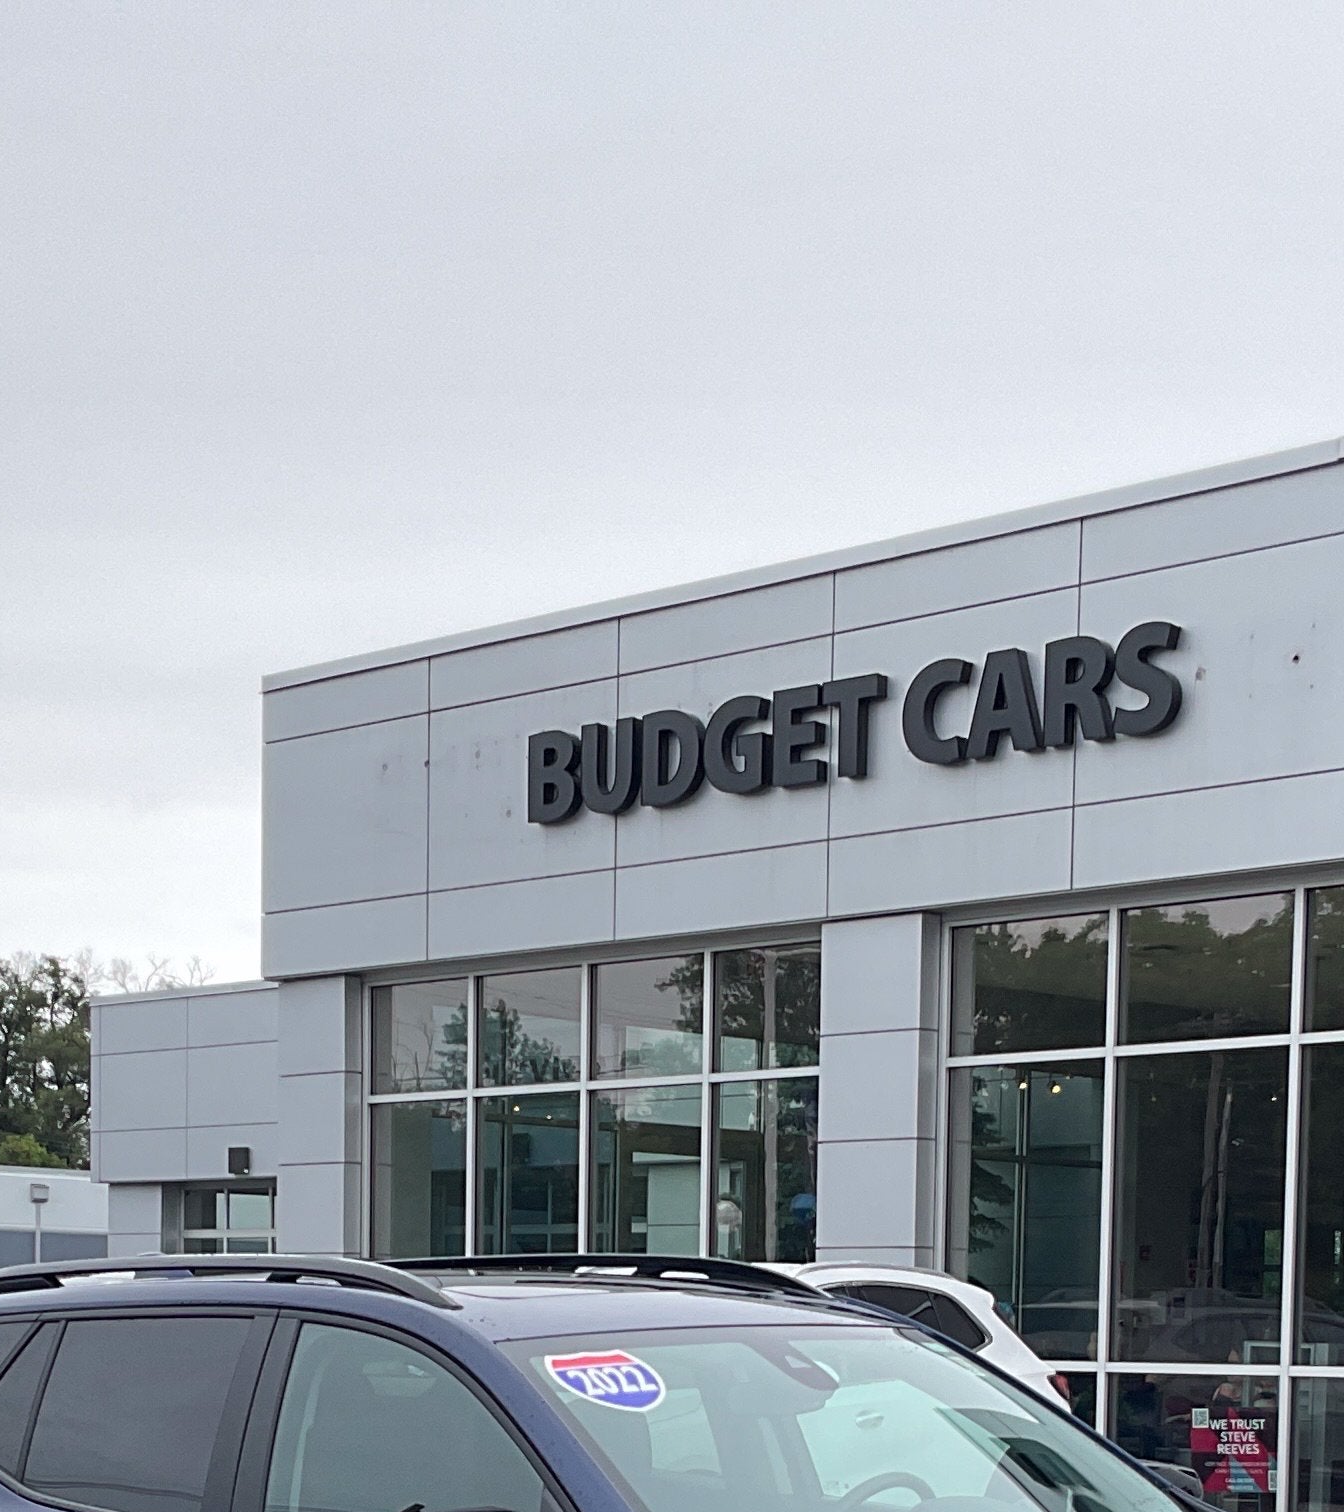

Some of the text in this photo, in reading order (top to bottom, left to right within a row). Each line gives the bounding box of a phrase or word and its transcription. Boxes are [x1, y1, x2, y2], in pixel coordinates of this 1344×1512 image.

[528, 620, 1182, 824] BUDGET CARS
[566, 1366, 658, 1395] 2022
[1209, 1418, 1265, 1430] WE TRUST
[1220, 1431, 1256, 1443] STEVE
[1217, 1443, 1260, 1455] REEVES
